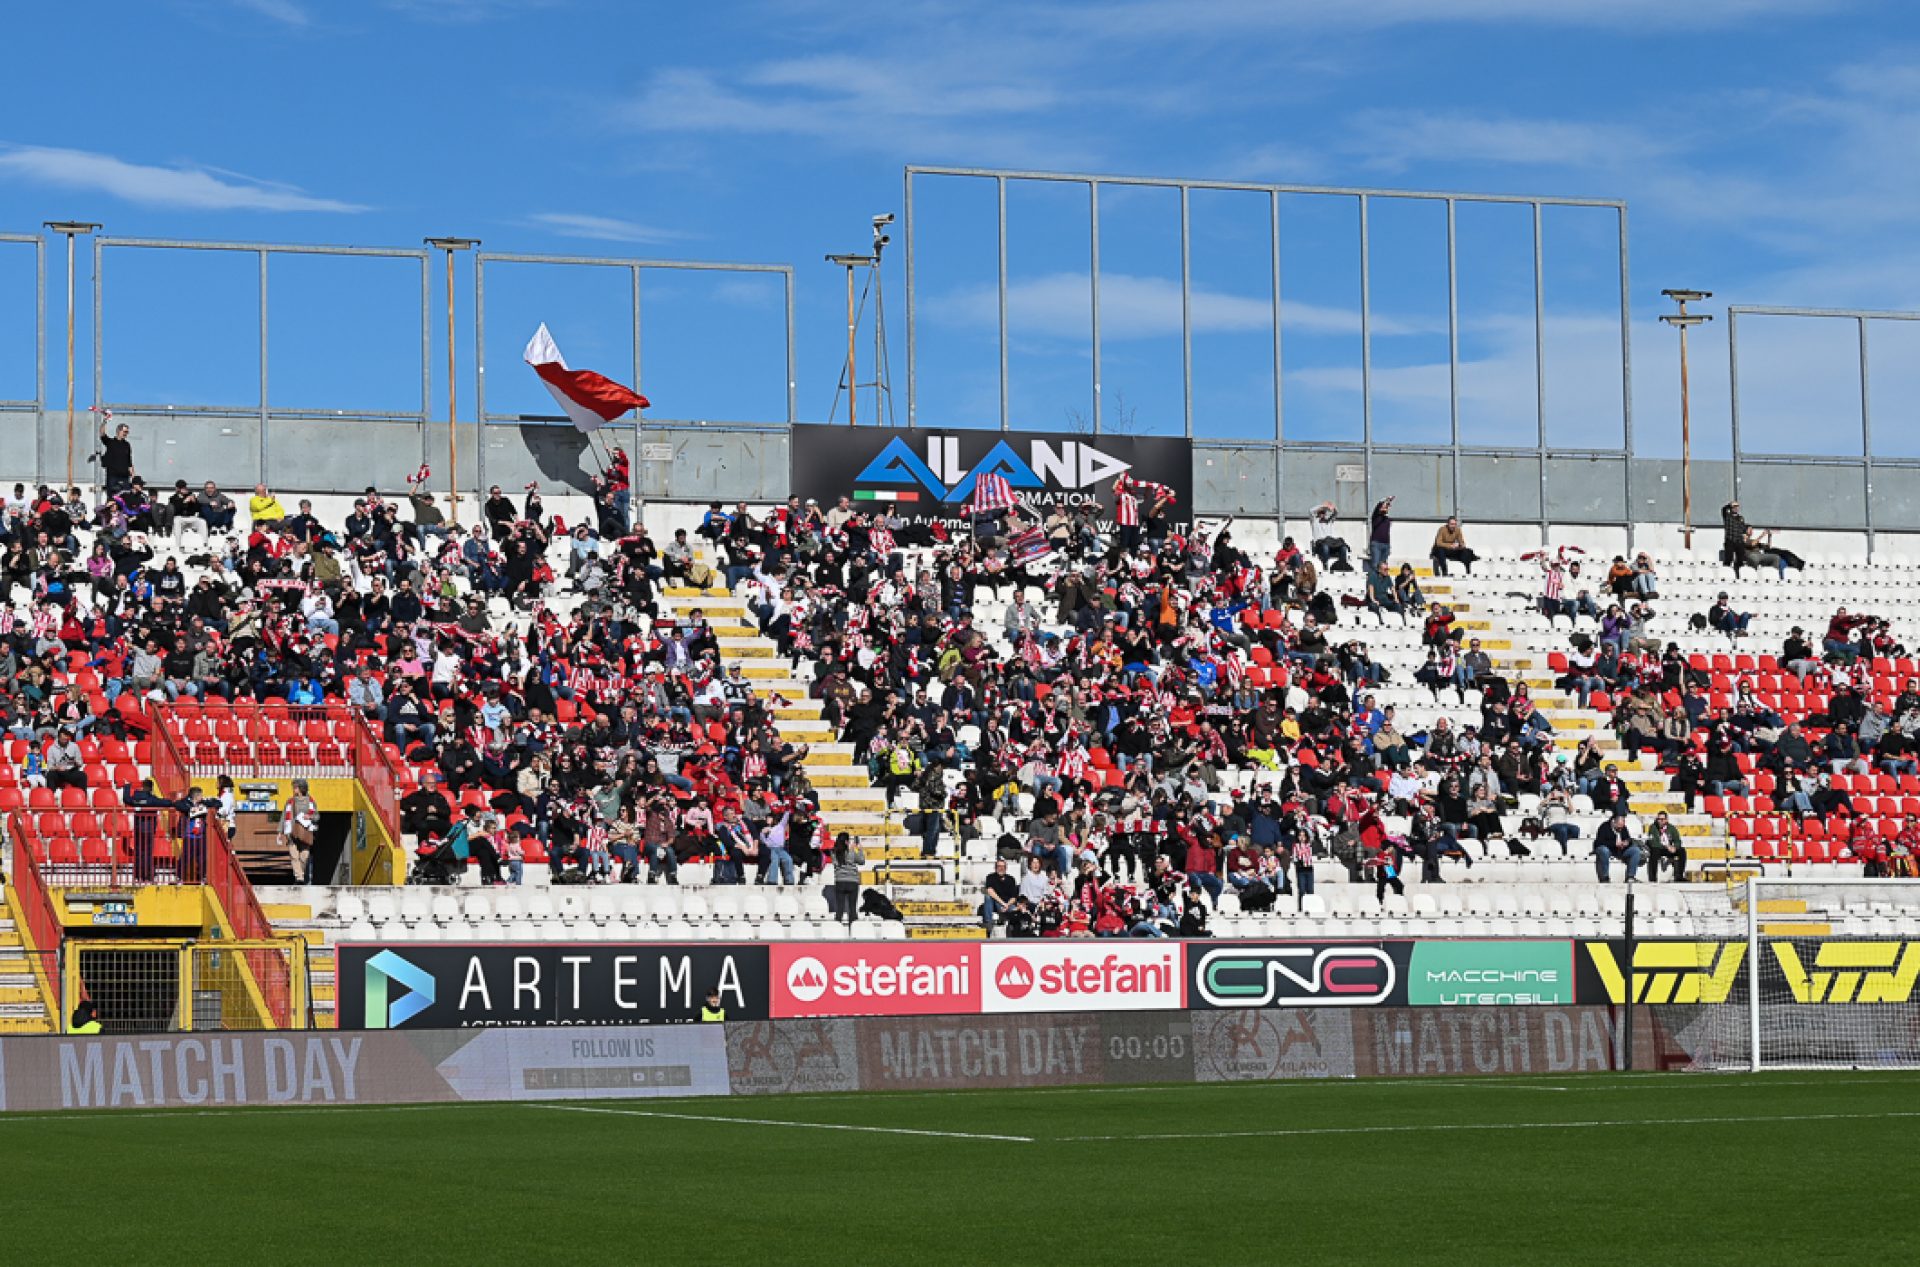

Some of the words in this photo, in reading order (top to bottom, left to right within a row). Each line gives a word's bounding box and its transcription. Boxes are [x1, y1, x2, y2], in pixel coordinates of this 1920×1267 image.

[854, 435, 1132, 502] AILAND
[458, 954, 746, 1010] ARTEMA
[833, 956, 969, 996] stefani
[1039, 955, 1171, 994] stefani
[1196, 947, 1396, 1007] CNC
[1426, 969, 1558, 983] MACCHINE
[1440, 992, 1559, 1005] UTENSILI
[572, 1038, 631, 1058] FOLLOW
[635, 1038, 655, 1057] US
[880, 1028, 1009, 1080] MATCH
[1019, 1026, 1088, 1076] DAY
[1109, 1034, 1186, 1060] 00:00
[1374, 1012, 1532, 1074] MATCH
[1543, 1010, 1625, 1071] DAY
[59, 1038, 247, 1107] MATCH
[264, 1037, 362, 1102] DAY
